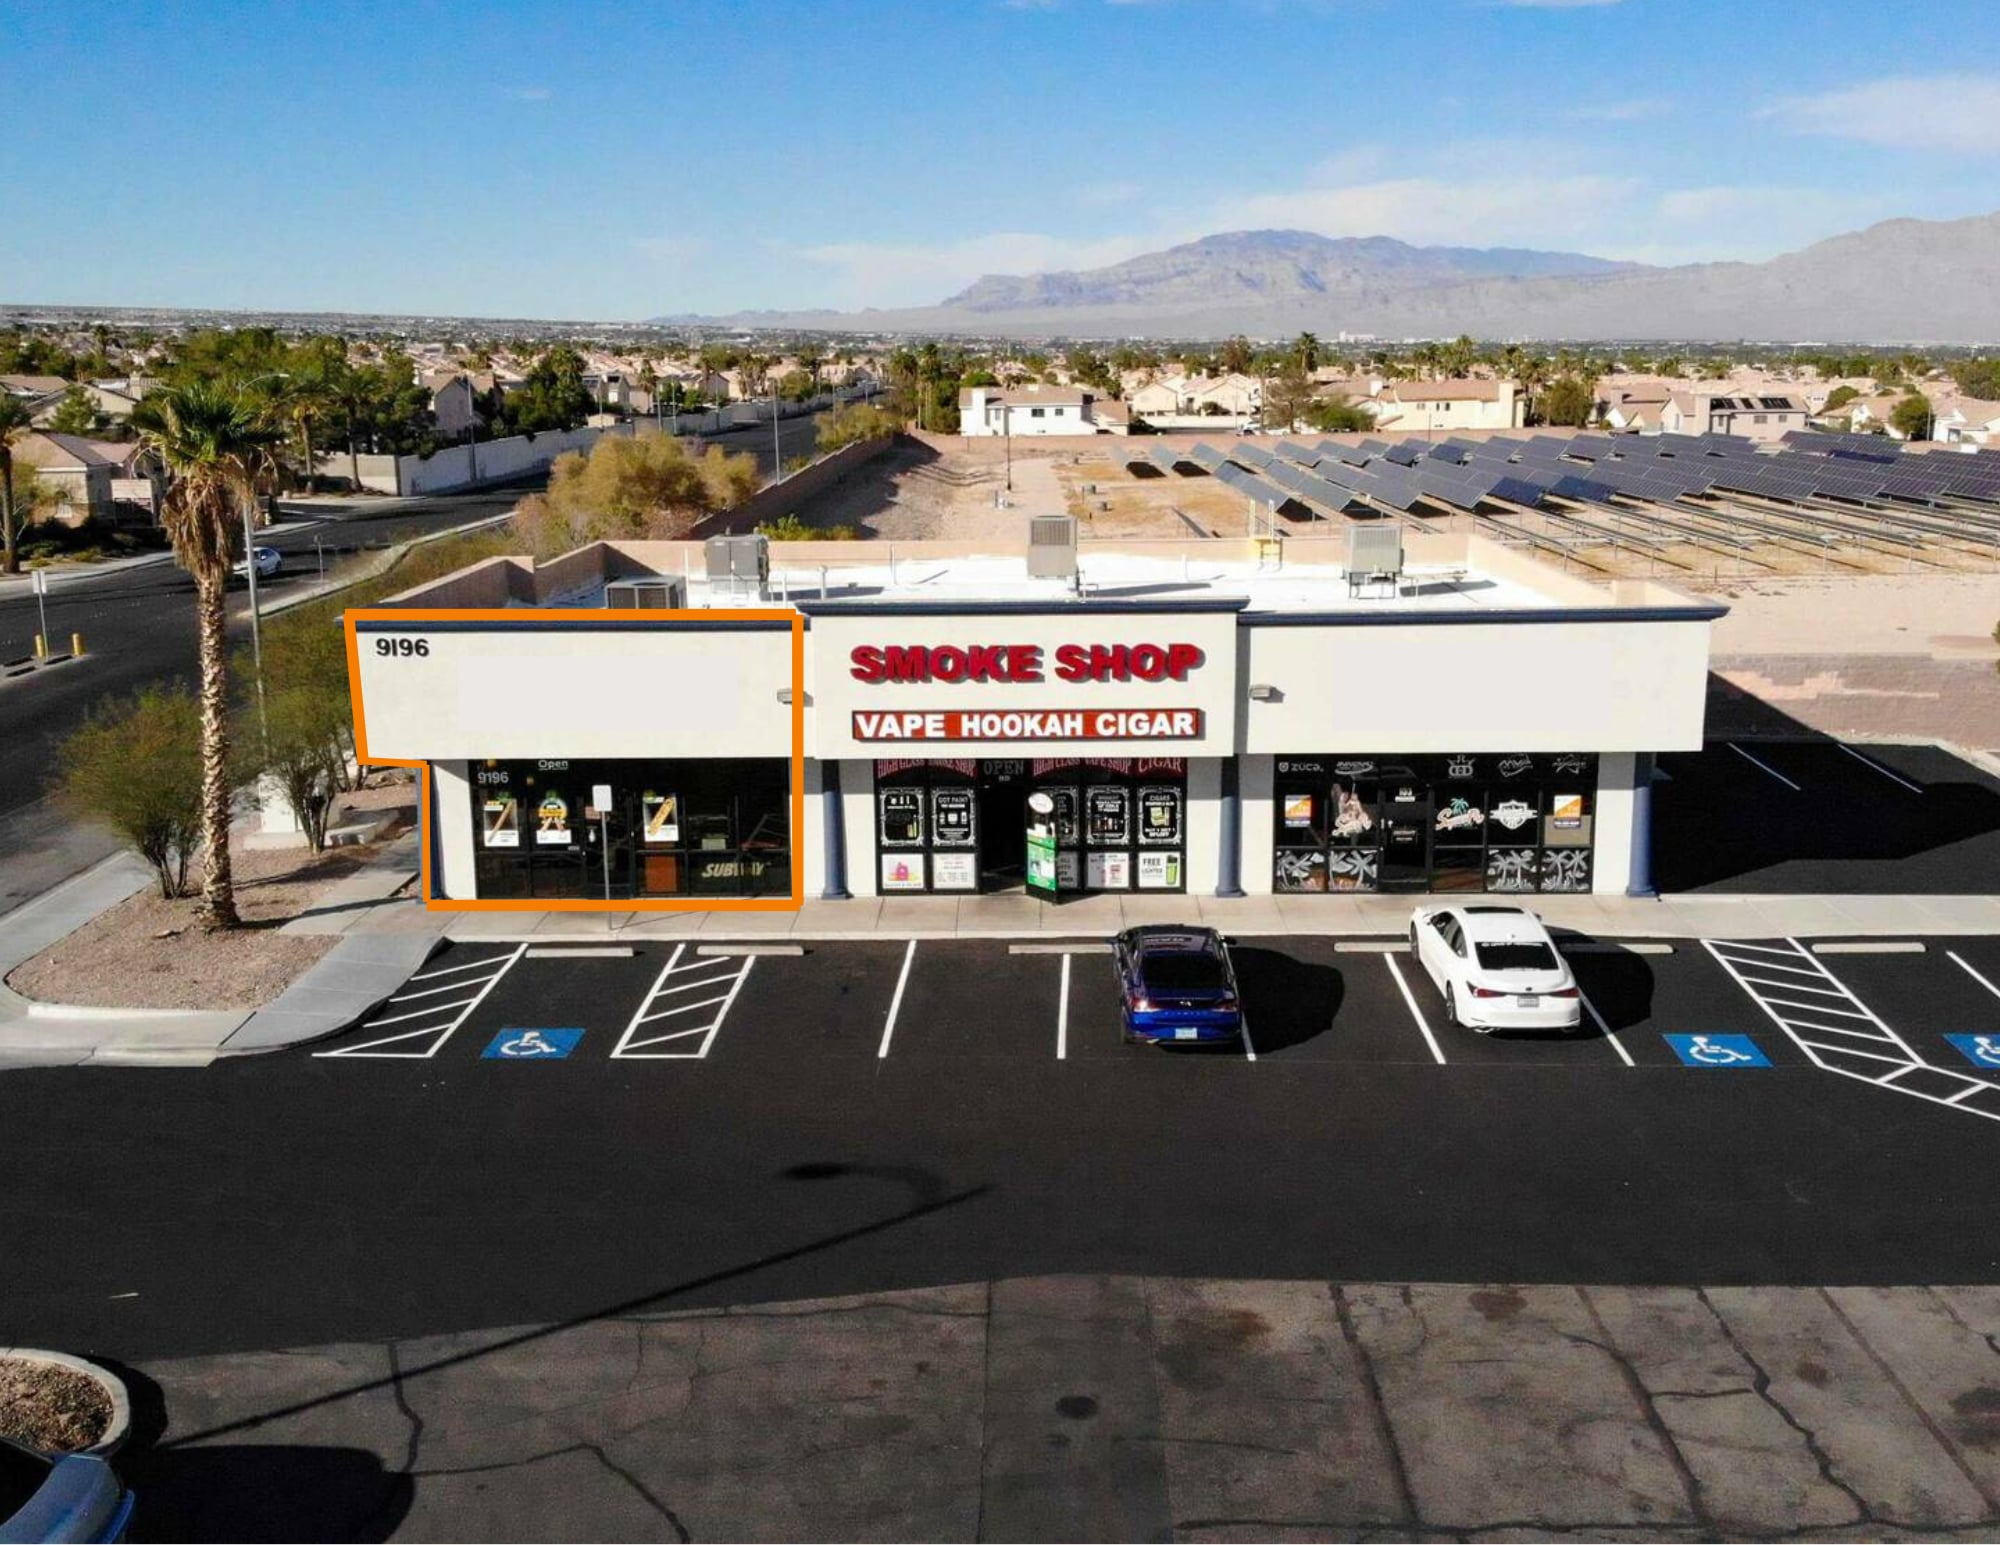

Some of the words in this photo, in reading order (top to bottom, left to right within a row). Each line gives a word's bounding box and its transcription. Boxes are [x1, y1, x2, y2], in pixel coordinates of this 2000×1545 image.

[376, 638, 430, 657] 9196
[850, 645, 1042, 682] SMOKE
[1055, 644, 1204, 681] SHOP
[855, 714, 945, 737] VAPE
[961, 713, 1083, 736] HOOKAH
[1096, 712, 1195, 736] CIGAR
[538, 760, 568, 769] Open
[983, 760, 1024, 776] OPEN
[478, 772, 509, 784] 9196
[1142, 858, 1161, 866] FREE
